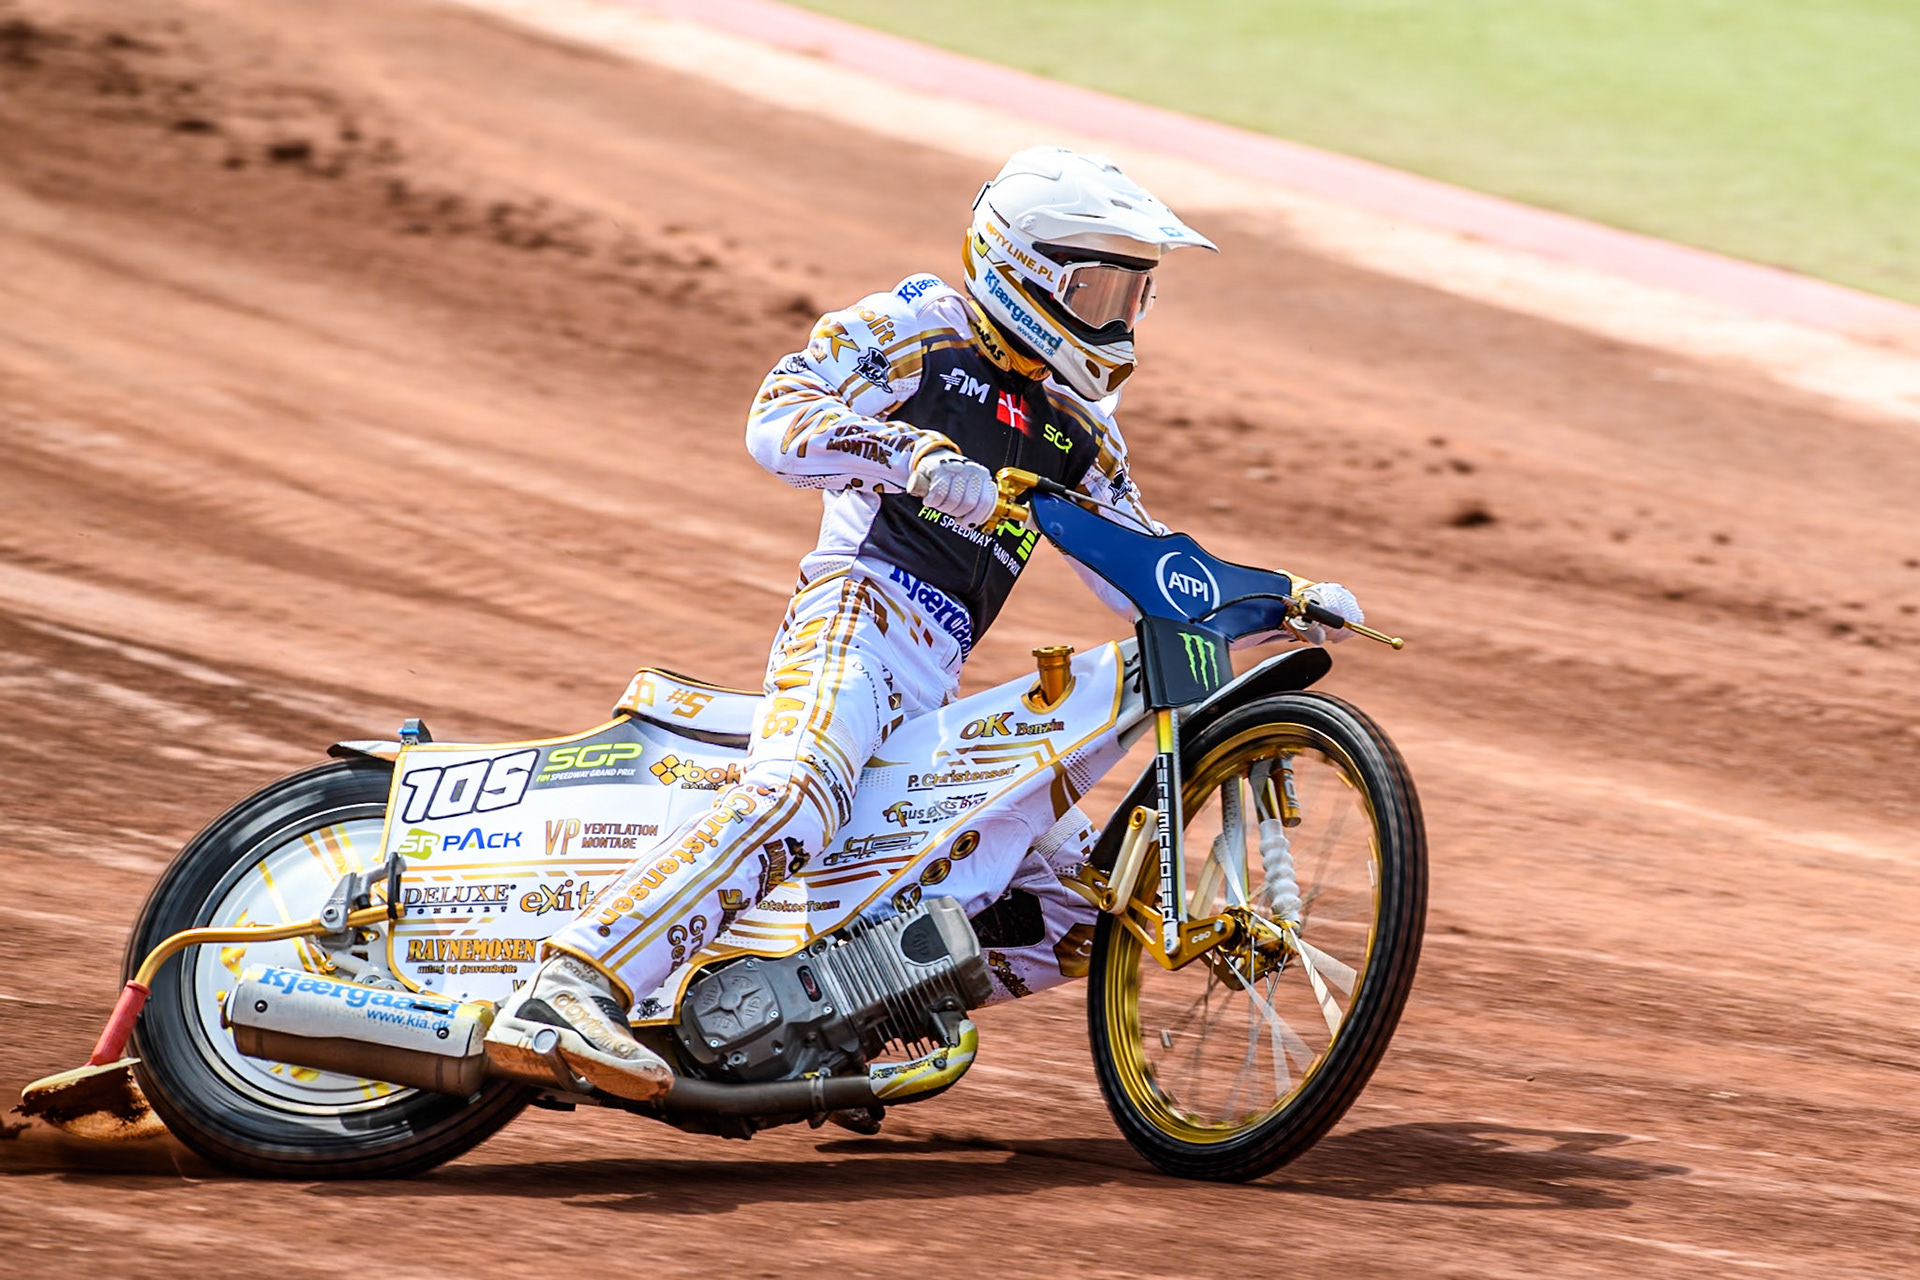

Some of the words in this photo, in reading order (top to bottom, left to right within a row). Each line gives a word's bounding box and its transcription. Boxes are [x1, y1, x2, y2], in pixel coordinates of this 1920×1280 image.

[984, 268, 1064, 351] Kjærgaard
[917, 506, 942, 523] FIM
[940, 515, 993, 547] SPEEDWAY
[1167, 571, 1209, 602] ATPI
[543, 742, 644, 772] SGP
[401, 748, 541, 824] 105
[550, 770, 590, 781] SPEEDWAY
[589, 768, 617, 777] GRAND
[617, 768, 637, 776] PRIX
[443, 827, 523, 852] PACK
[545, 819, 580, 856] VP
[584, 823, 658, 837] VENTILATION
[406, 939, 537, 963] RAVNEMOSEN
[366, 1008, 451, 1031] www.kia.dk
